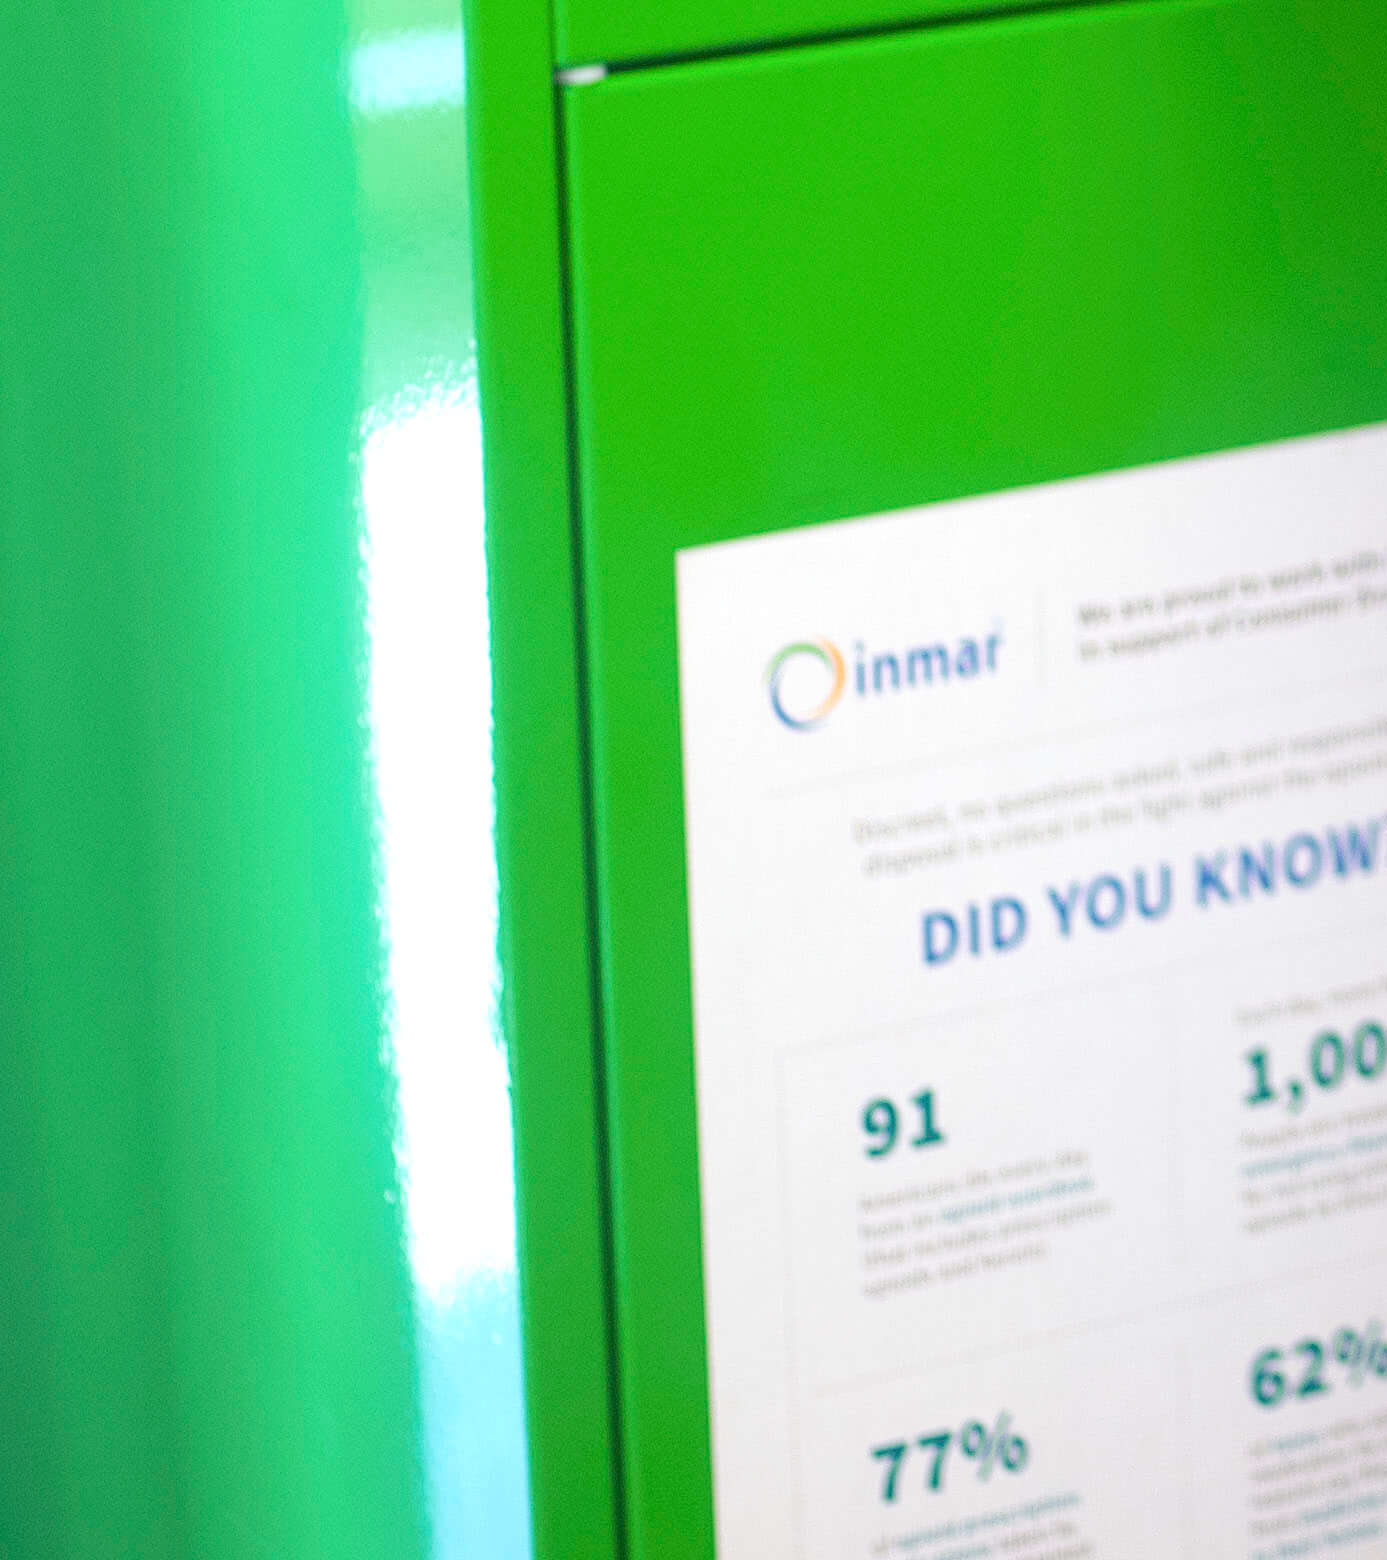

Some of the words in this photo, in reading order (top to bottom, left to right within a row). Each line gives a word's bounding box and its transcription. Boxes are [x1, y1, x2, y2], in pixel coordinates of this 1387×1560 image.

[855, 631, 1004, 696] inmar
[920, 895, 1028, 967] DID
[1045, 862, 1174, 938] YOU
[862, 1087, 948, 1158] 91
[871, 1410, 1029, 1503] 77%
